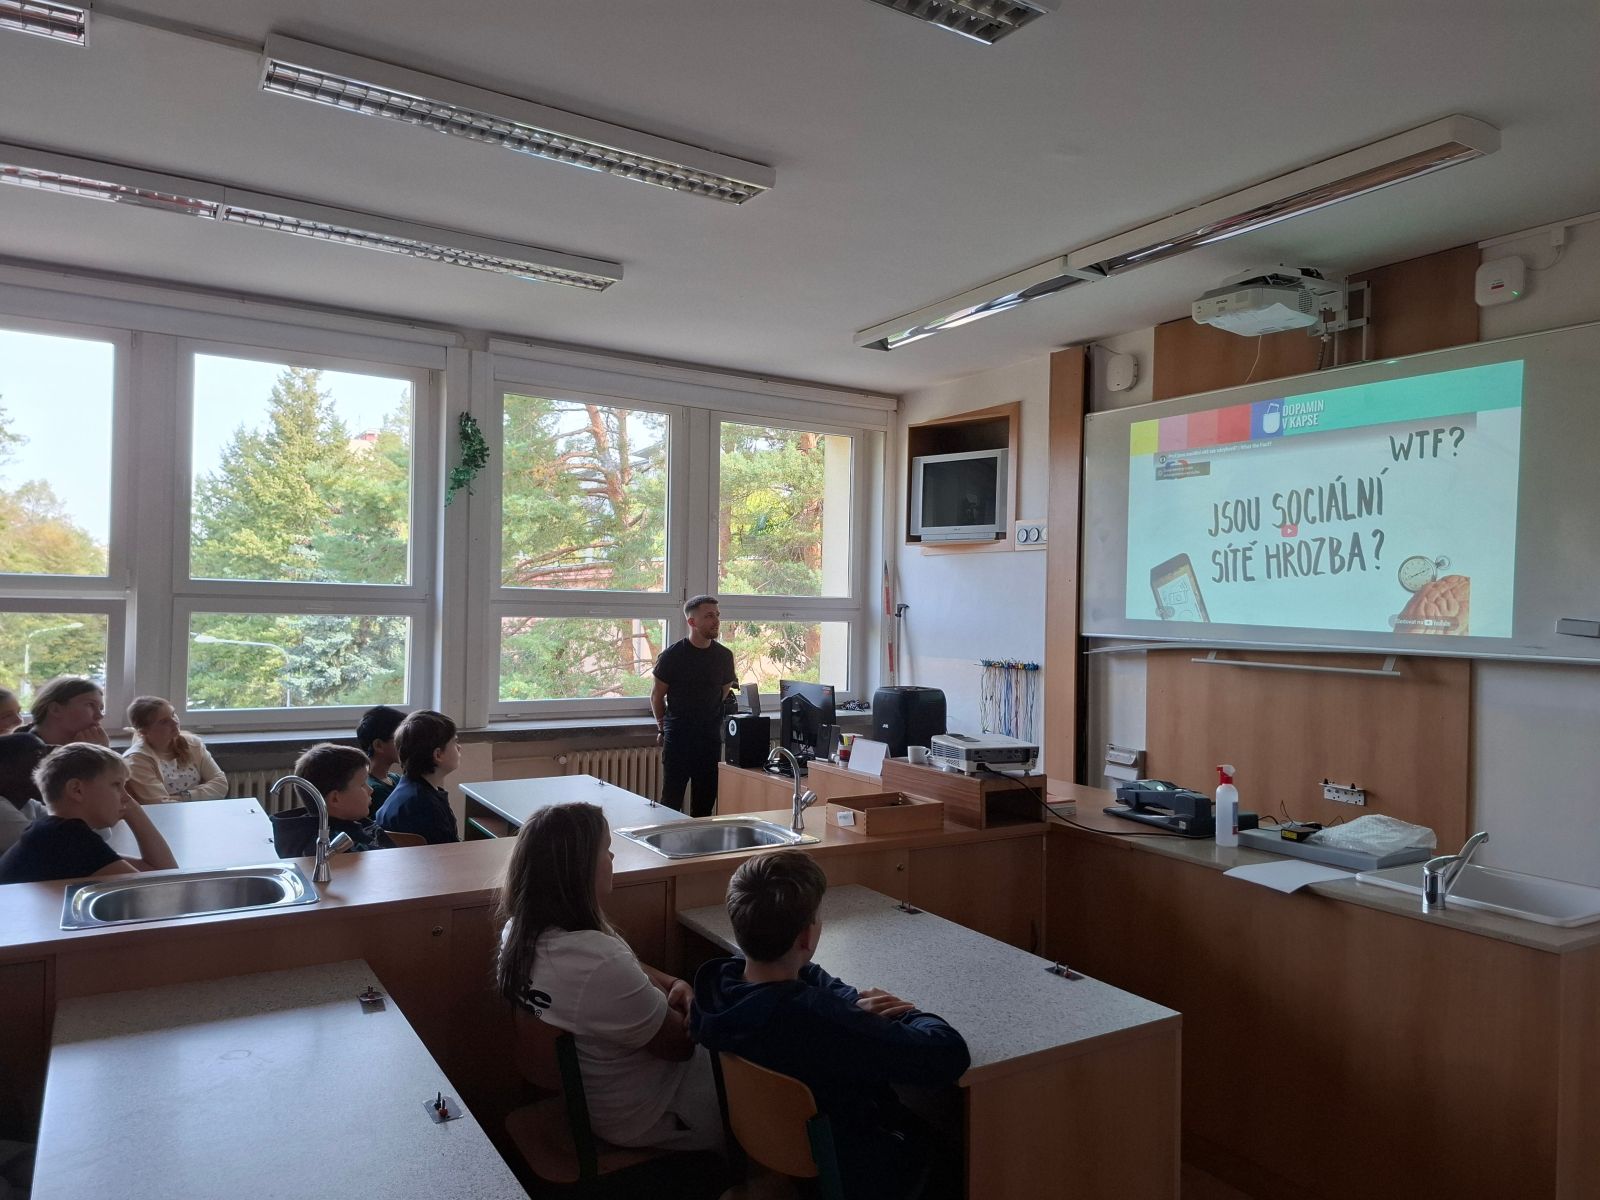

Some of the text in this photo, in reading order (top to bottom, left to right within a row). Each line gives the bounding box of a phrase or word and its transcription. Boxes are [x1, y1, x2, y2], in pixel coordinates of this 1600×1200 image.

[1282, 399, 1324, 417] DOPAMIN
[1282, 413, 1319, 429] V KAPSE
[1389, 426, 1465, 462] WTF?
[1208, 467, 1389, 537] JSOU SOCIÁLNÍ
[1211, 529, 1385, 584] SÍTĚ HROZBA?
